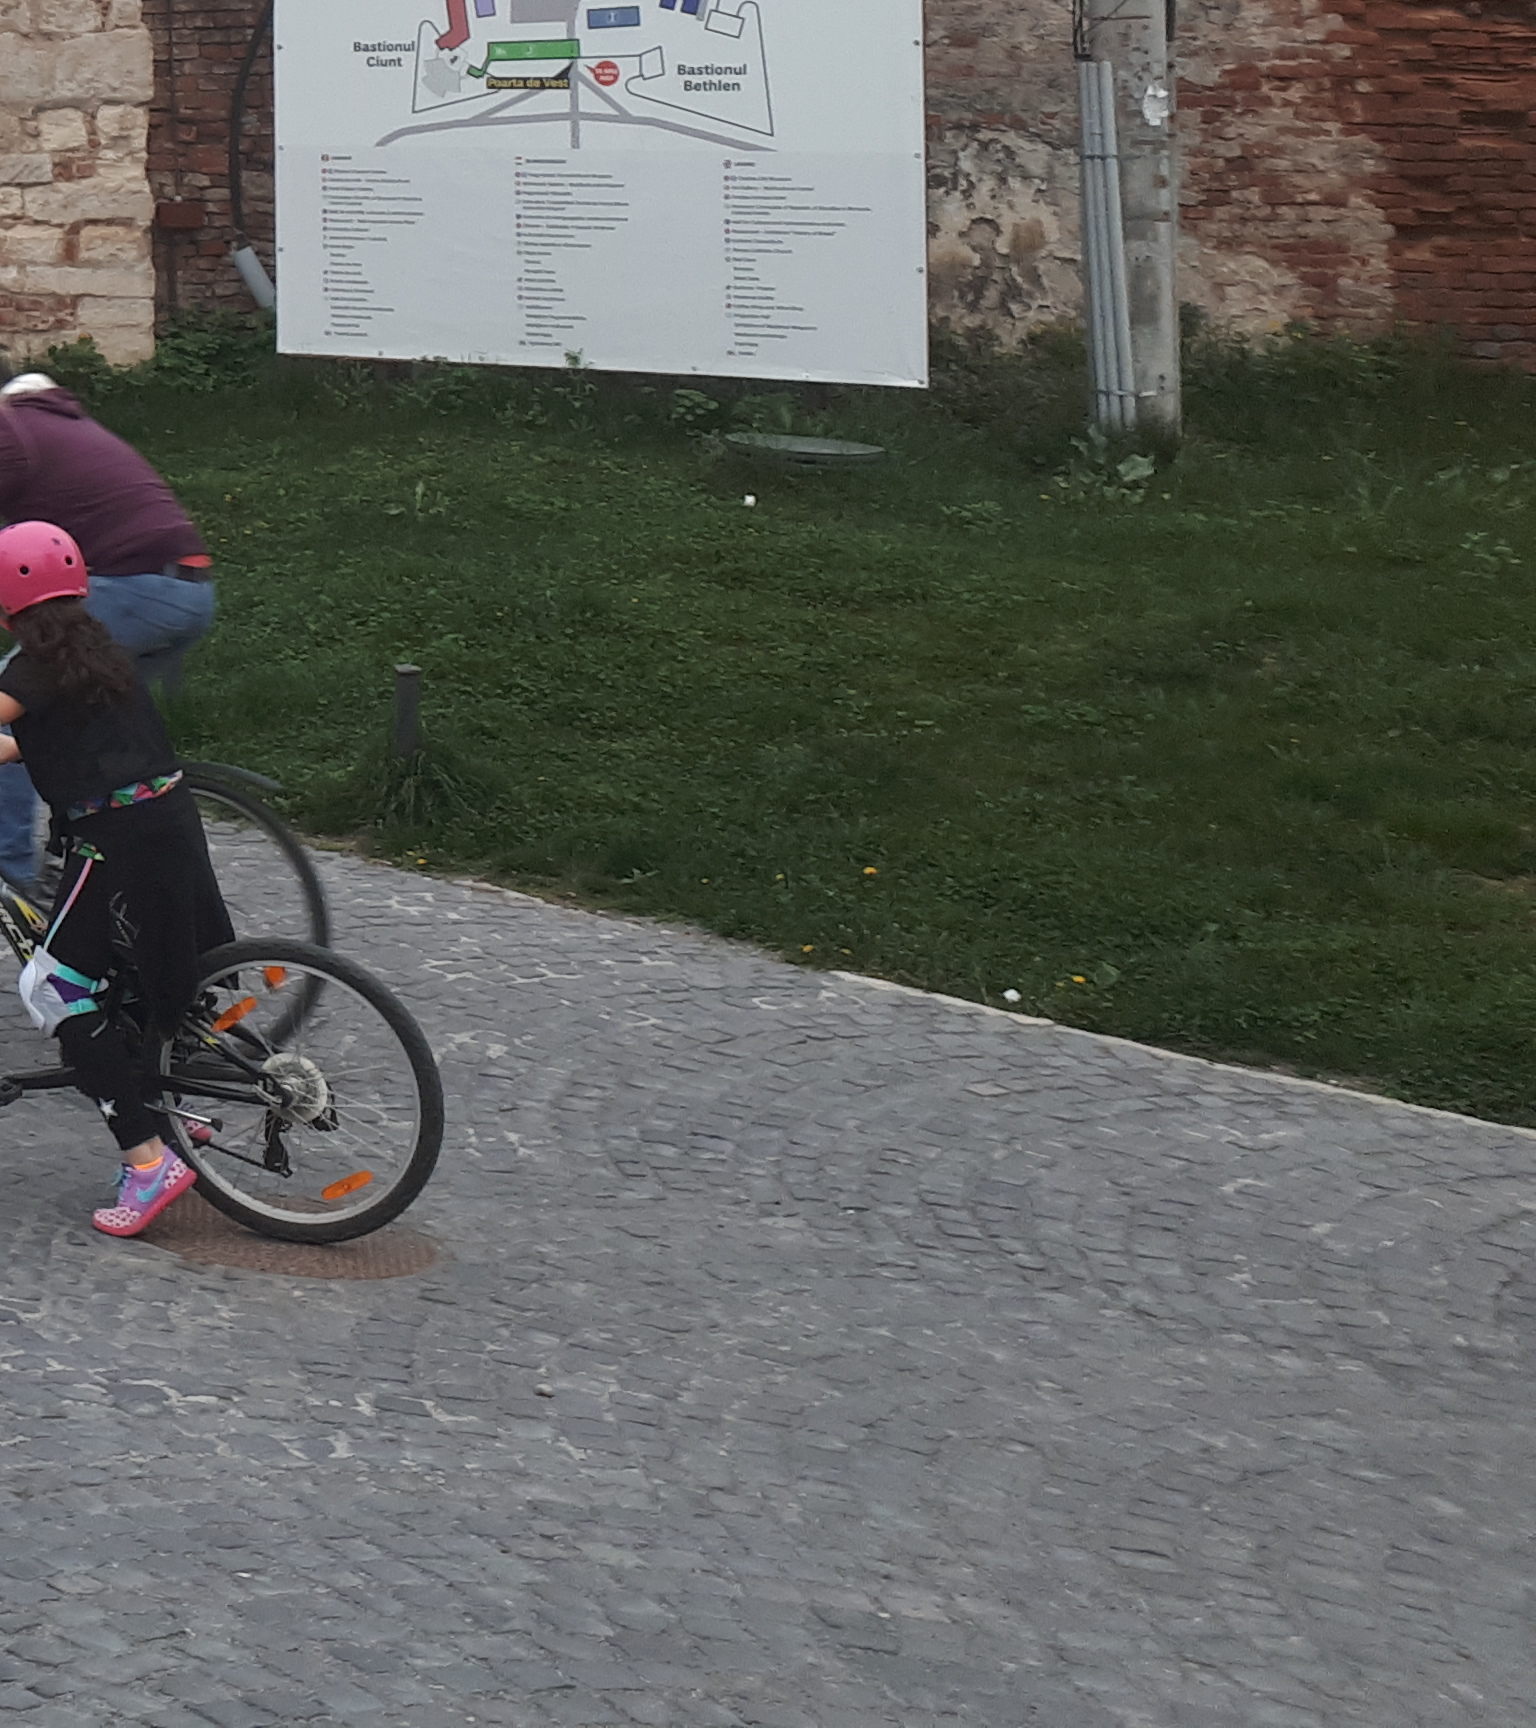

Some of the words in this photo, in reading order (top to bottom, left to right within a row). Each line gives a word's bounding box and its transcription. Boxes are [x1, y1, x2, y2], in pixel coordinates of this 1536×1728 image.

[353, 41, 415, 53] Bastionul
[366, 57, 403, 68] Ciunt
[677, 64, 747, 76] Bastionul
[683, 80, 741, 93] Bethlen
